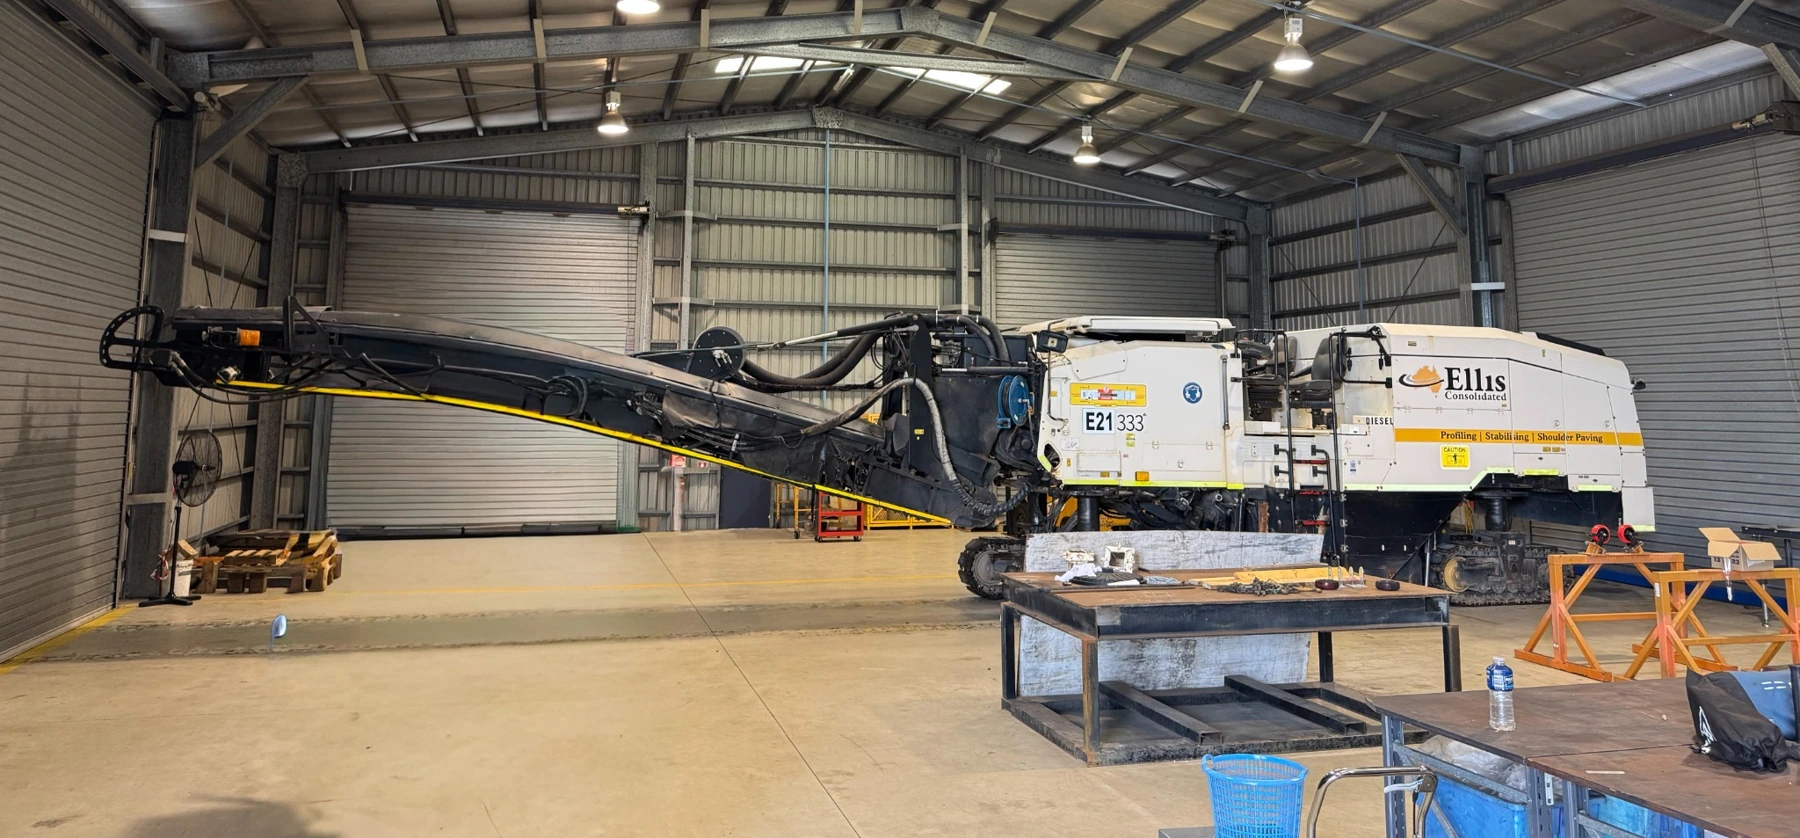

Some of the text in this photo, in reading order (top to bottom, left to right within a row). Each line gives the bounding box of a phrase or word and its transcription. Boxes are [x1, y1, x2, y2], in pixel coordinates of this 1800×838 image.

[1444, 367, 1506, 392] Ellis
[1444, 391, 1507, 401] Consolidated
[1086, 412, 1112, 431] E21
[1365, 417, 1394, 425] DIESEL
[1440, 431, 1477, 442] Profiling
[1485, 431, 1530, 442] Stabilising
[1537, 432, 1574, 442] Shoulder
[1575, 433, 1604, 444] Paving
